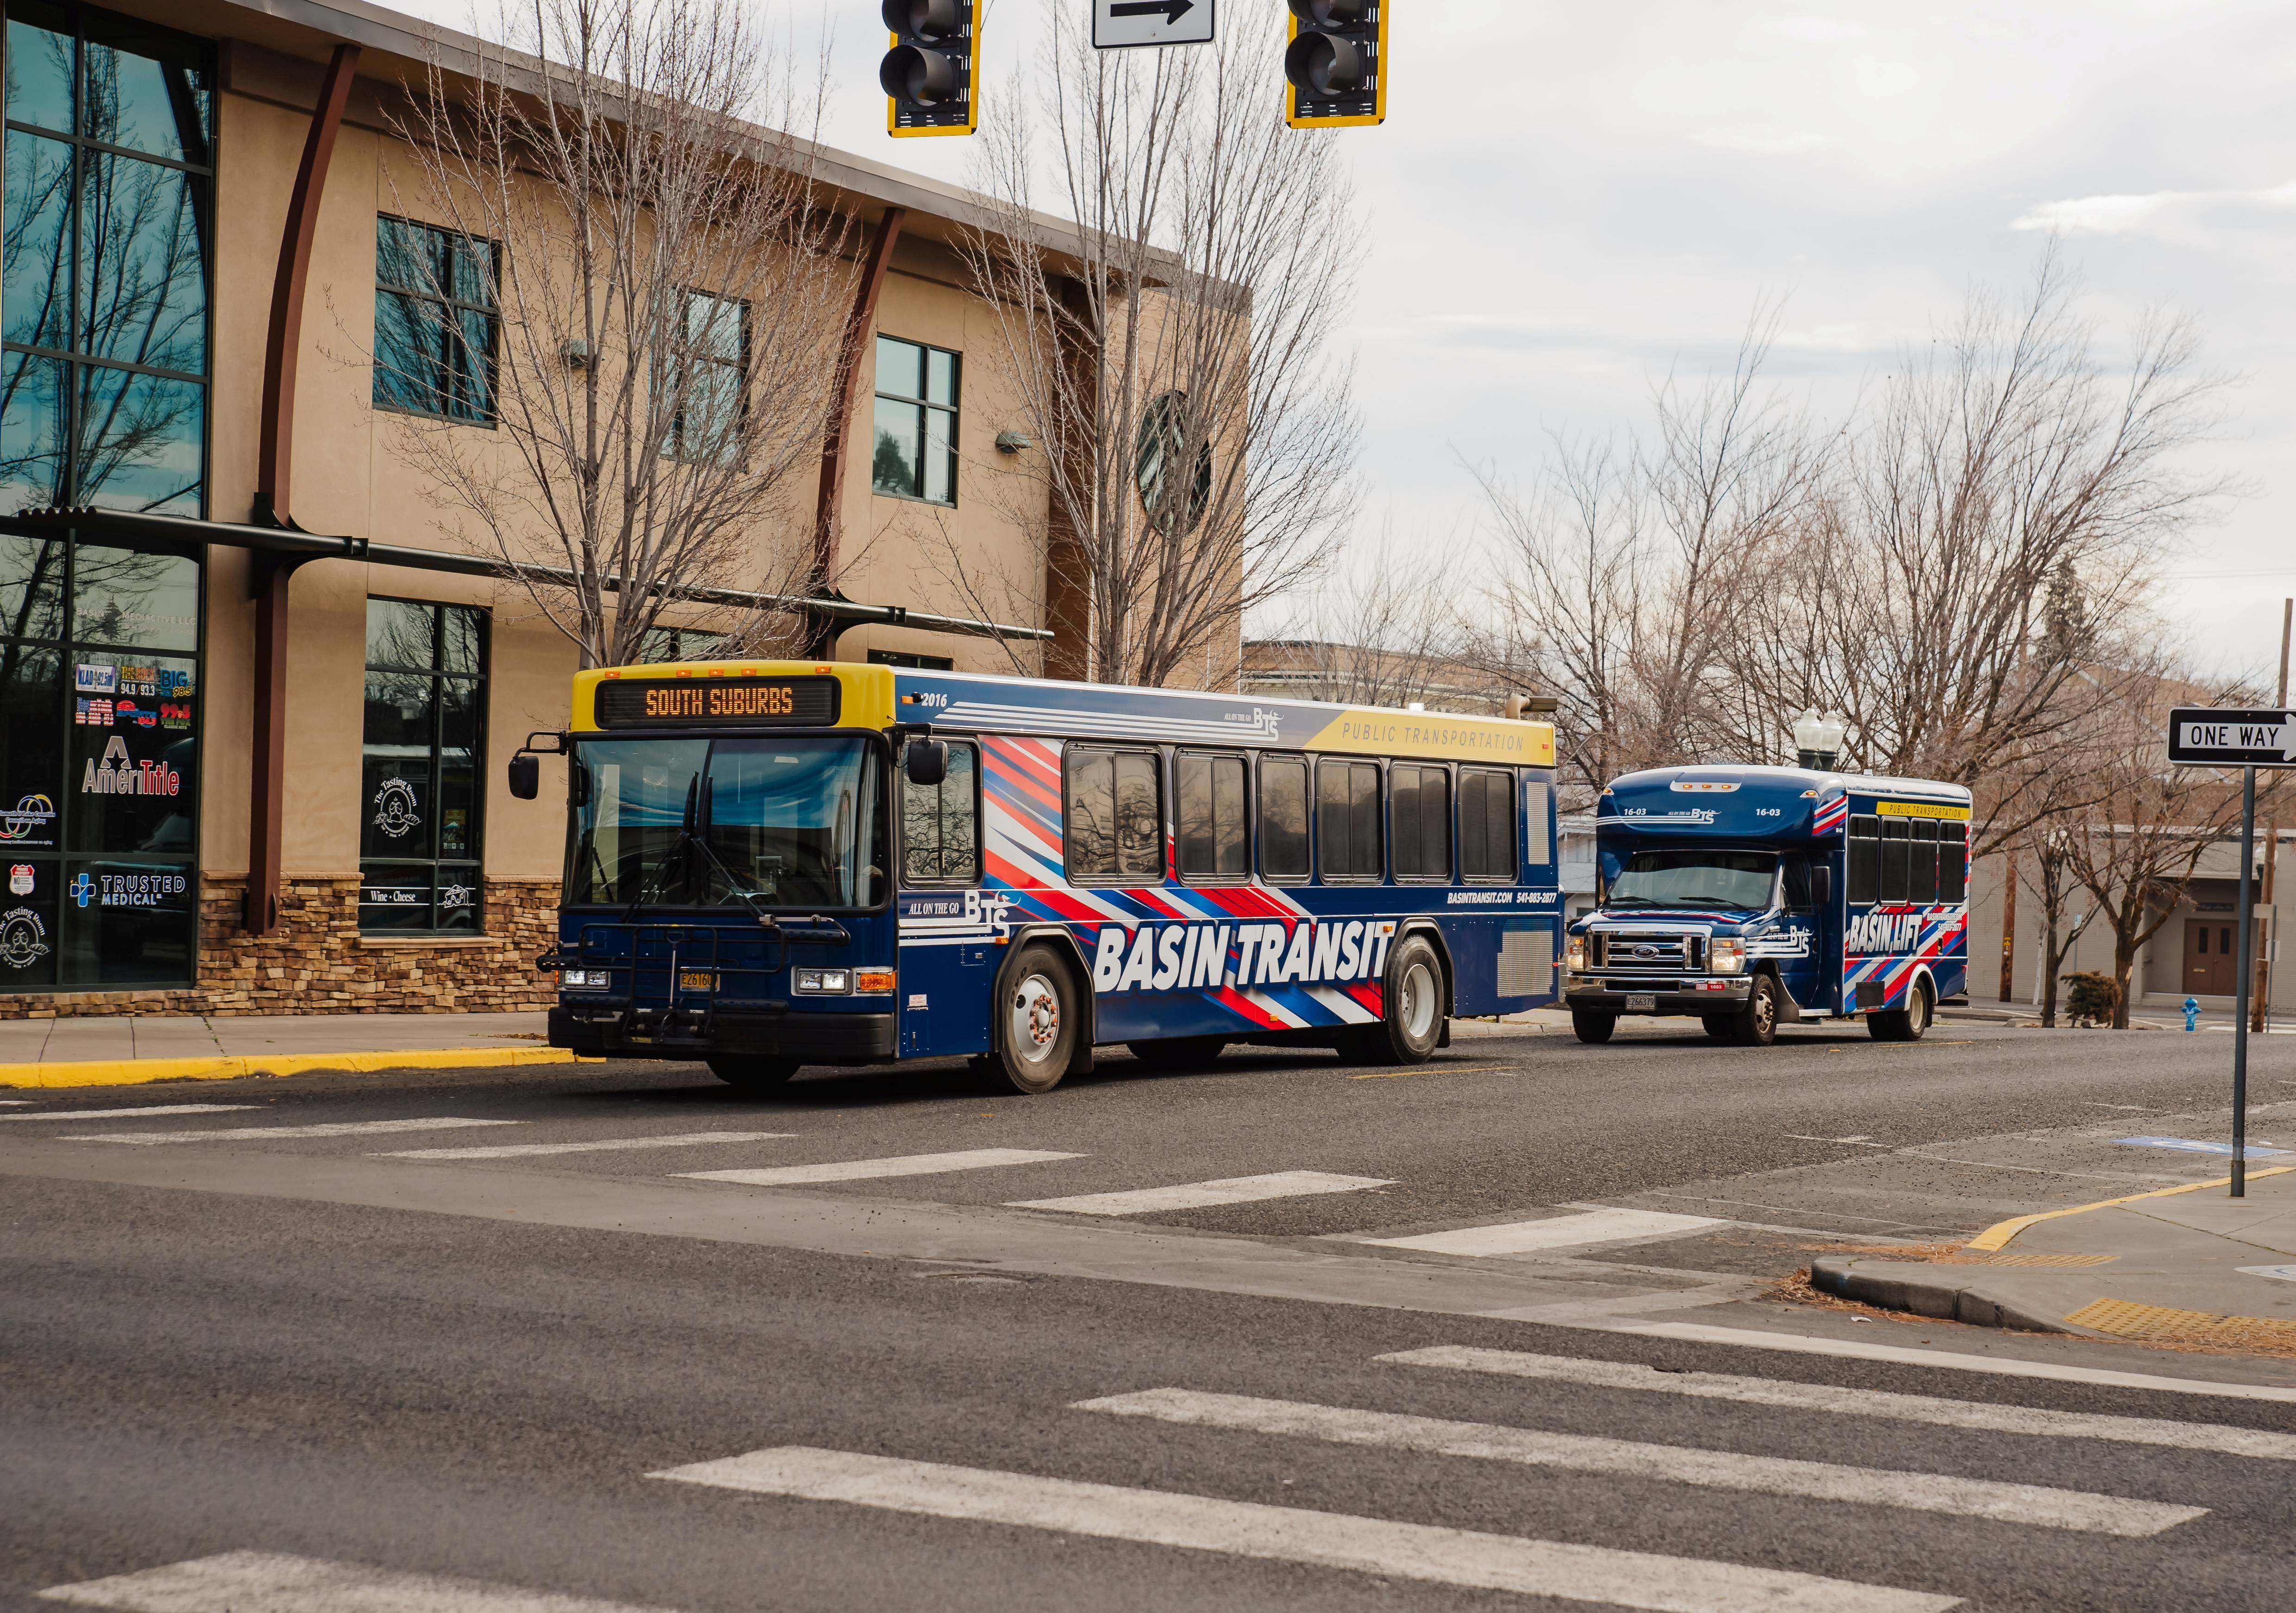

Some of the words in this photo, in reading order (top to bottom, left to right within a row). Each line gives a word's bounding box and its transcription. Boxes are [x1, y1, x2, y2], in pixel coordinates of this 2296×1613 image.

[160, 668, 189, 689] BIG
[647, 689, 703, 715] SOUTH
[710, 687, 793, 714] SUBURBS
[921, 693, 948, 707] 2016
[160, 703, 190, 719] 99.5
[1254, 707, 1279, 741] BTS
[1342, 722, 1395, 742] PUBLIC
[1405, 727, 1523, 751] TRANSPORTATION
[2191, 725, 2228, 745] ONE
[2239, 726, 2279, 747] WAY
[374, 790, 384, 804] The
[381, 777, 408, 790] Tasting
[406, 784, 417, 806] Room
[1691, 808, 1714, 824] BTS
[1889, 804, 1910, 814] PUBLIC
[1913, 805, 1962, 818] TRANSPORTATION
[101, 875, 185, 893] TRUSTED
[101, 893, 157, 905] MEDICAL
[371, 890, 388, 902] Wine
[393, 890, 415, 902] Cheese
[1447, 892, 1513, 904] BASINTRANSIT.COM
[1516, 892, 1557, 903] 541-883-2877
[3, 906, 34, 920] Tasting
[32, 913, 45, 936] Room
[909, 903, 922, 915] ALL
[923, 903, 933, 914] ON
[934, 903, 949, 914] THE
[949, 902, 959, 914] GO
[965, 890, 1010, 939] BTS
[1790, 925, 1809, 958] BTS
[1848, 914, 1893, 952] BASIN
[1893, 914, 1924, 951] LIFT
[1094, 924, 1230, 992] BASIN
[1237, 920, 1396, 985] TRANSIT
[1627, 997, 1654, 1006] E266379
